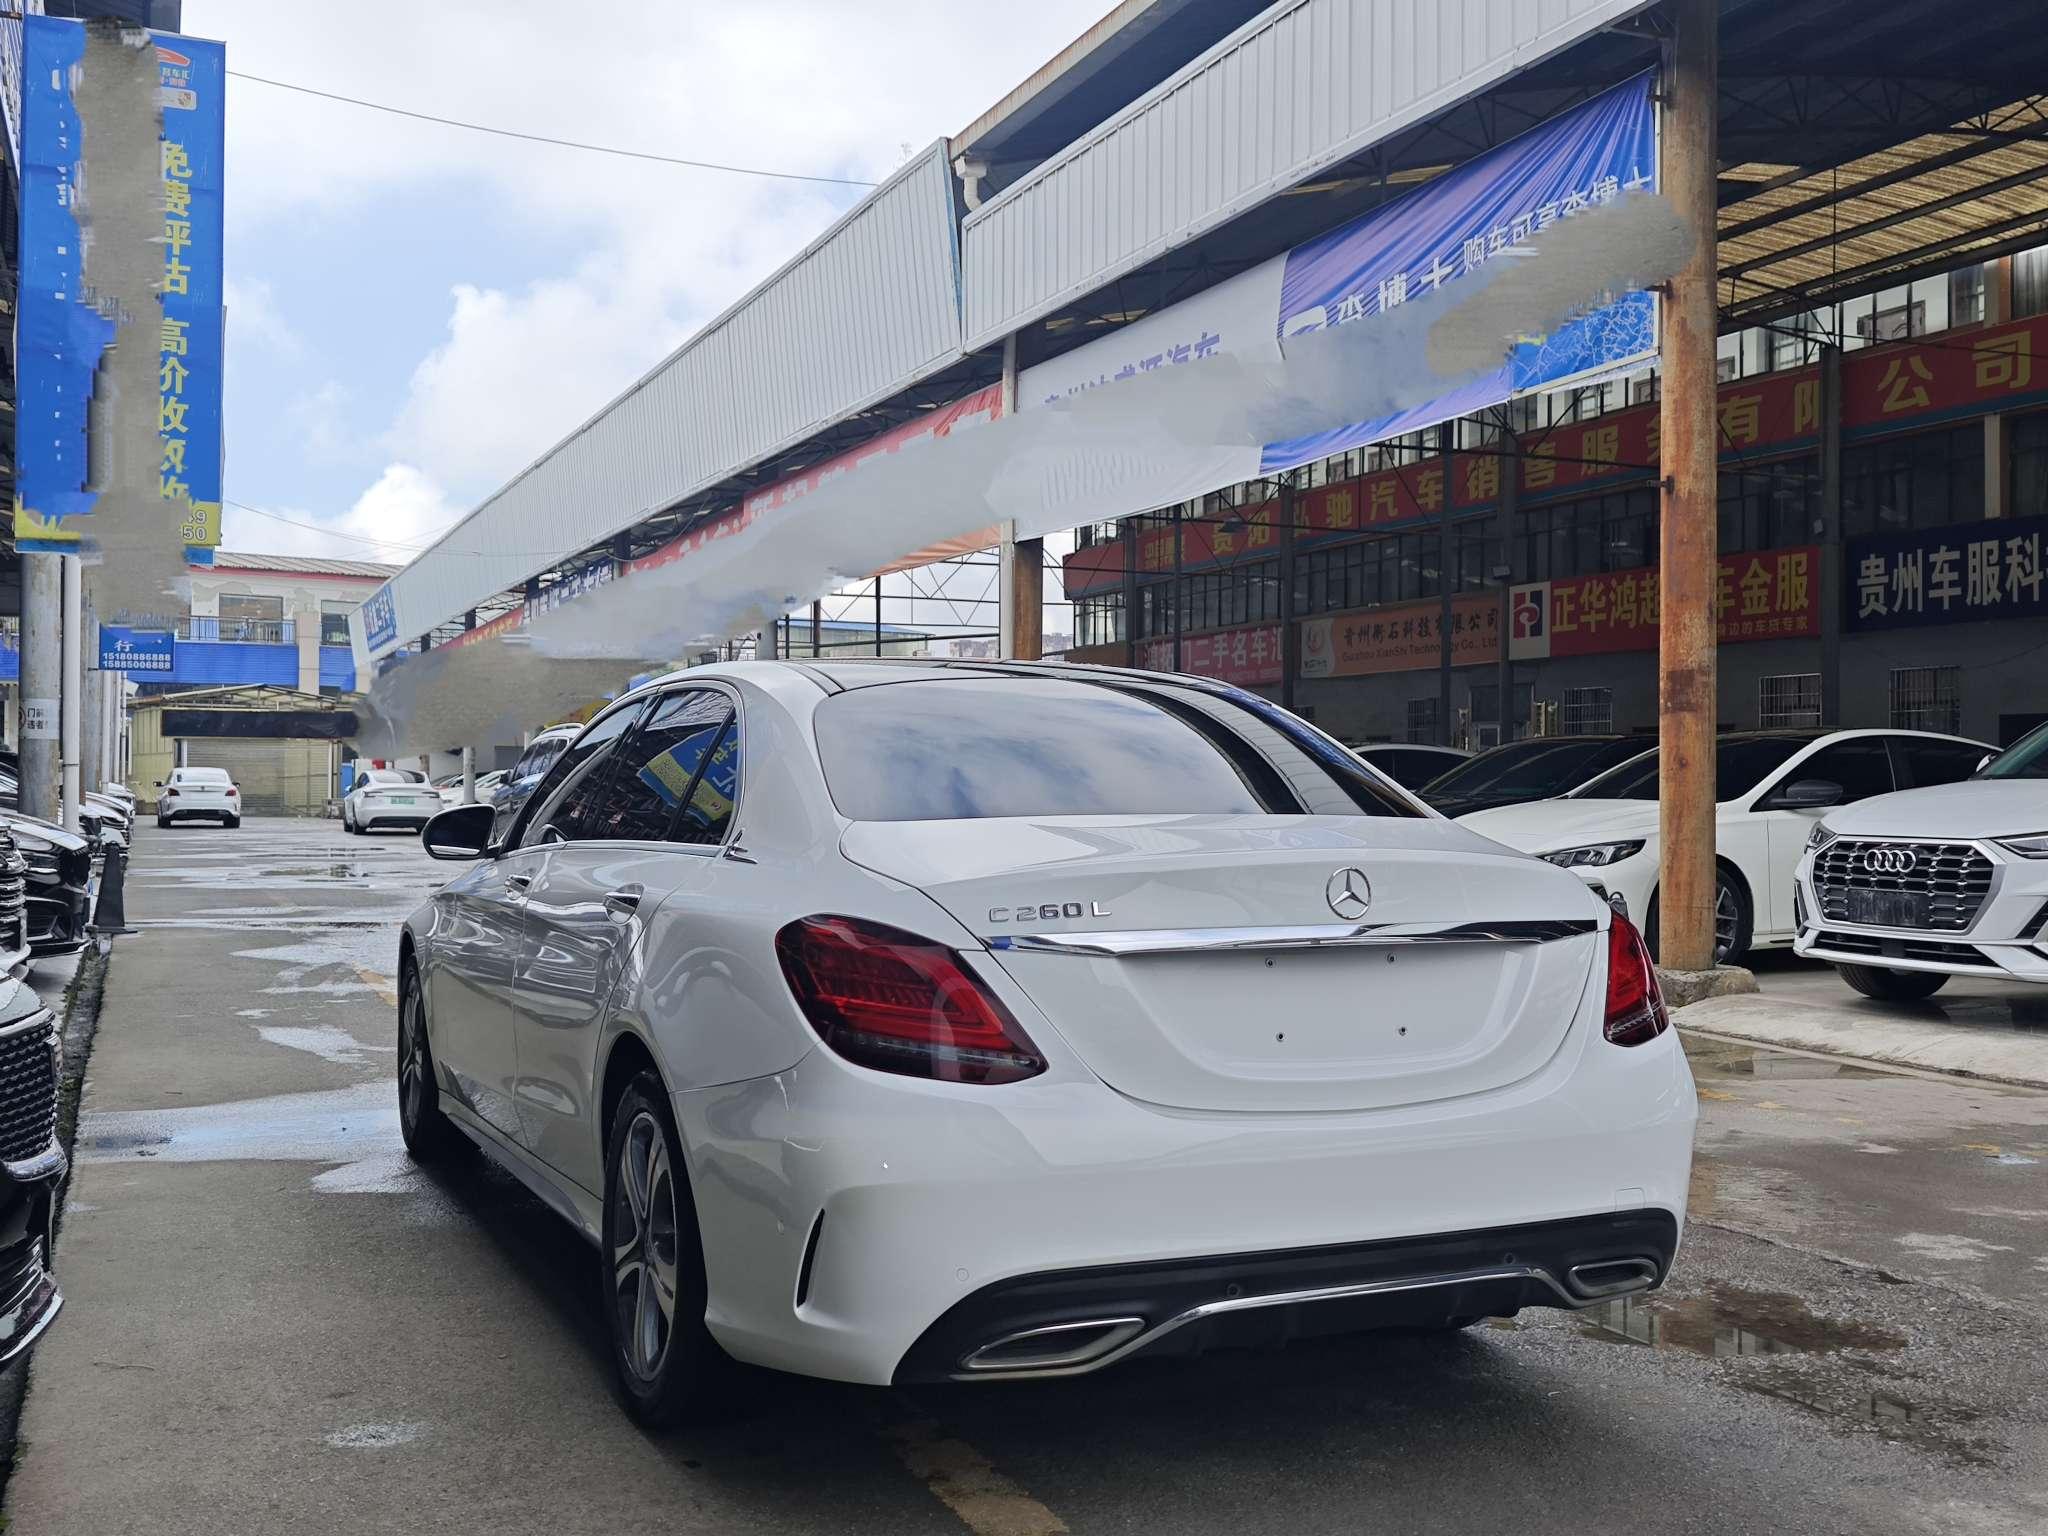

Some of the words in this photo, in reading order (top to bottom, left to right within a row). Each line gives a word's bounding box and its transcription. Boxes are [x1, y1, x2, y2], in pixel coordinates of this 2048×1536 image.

[1552, 553, 1809, 633] 正华鸿超车金服
[1857, 533, 2048, 619] 贵州车服科
[1409, 640, 1460, 657] Technogy
